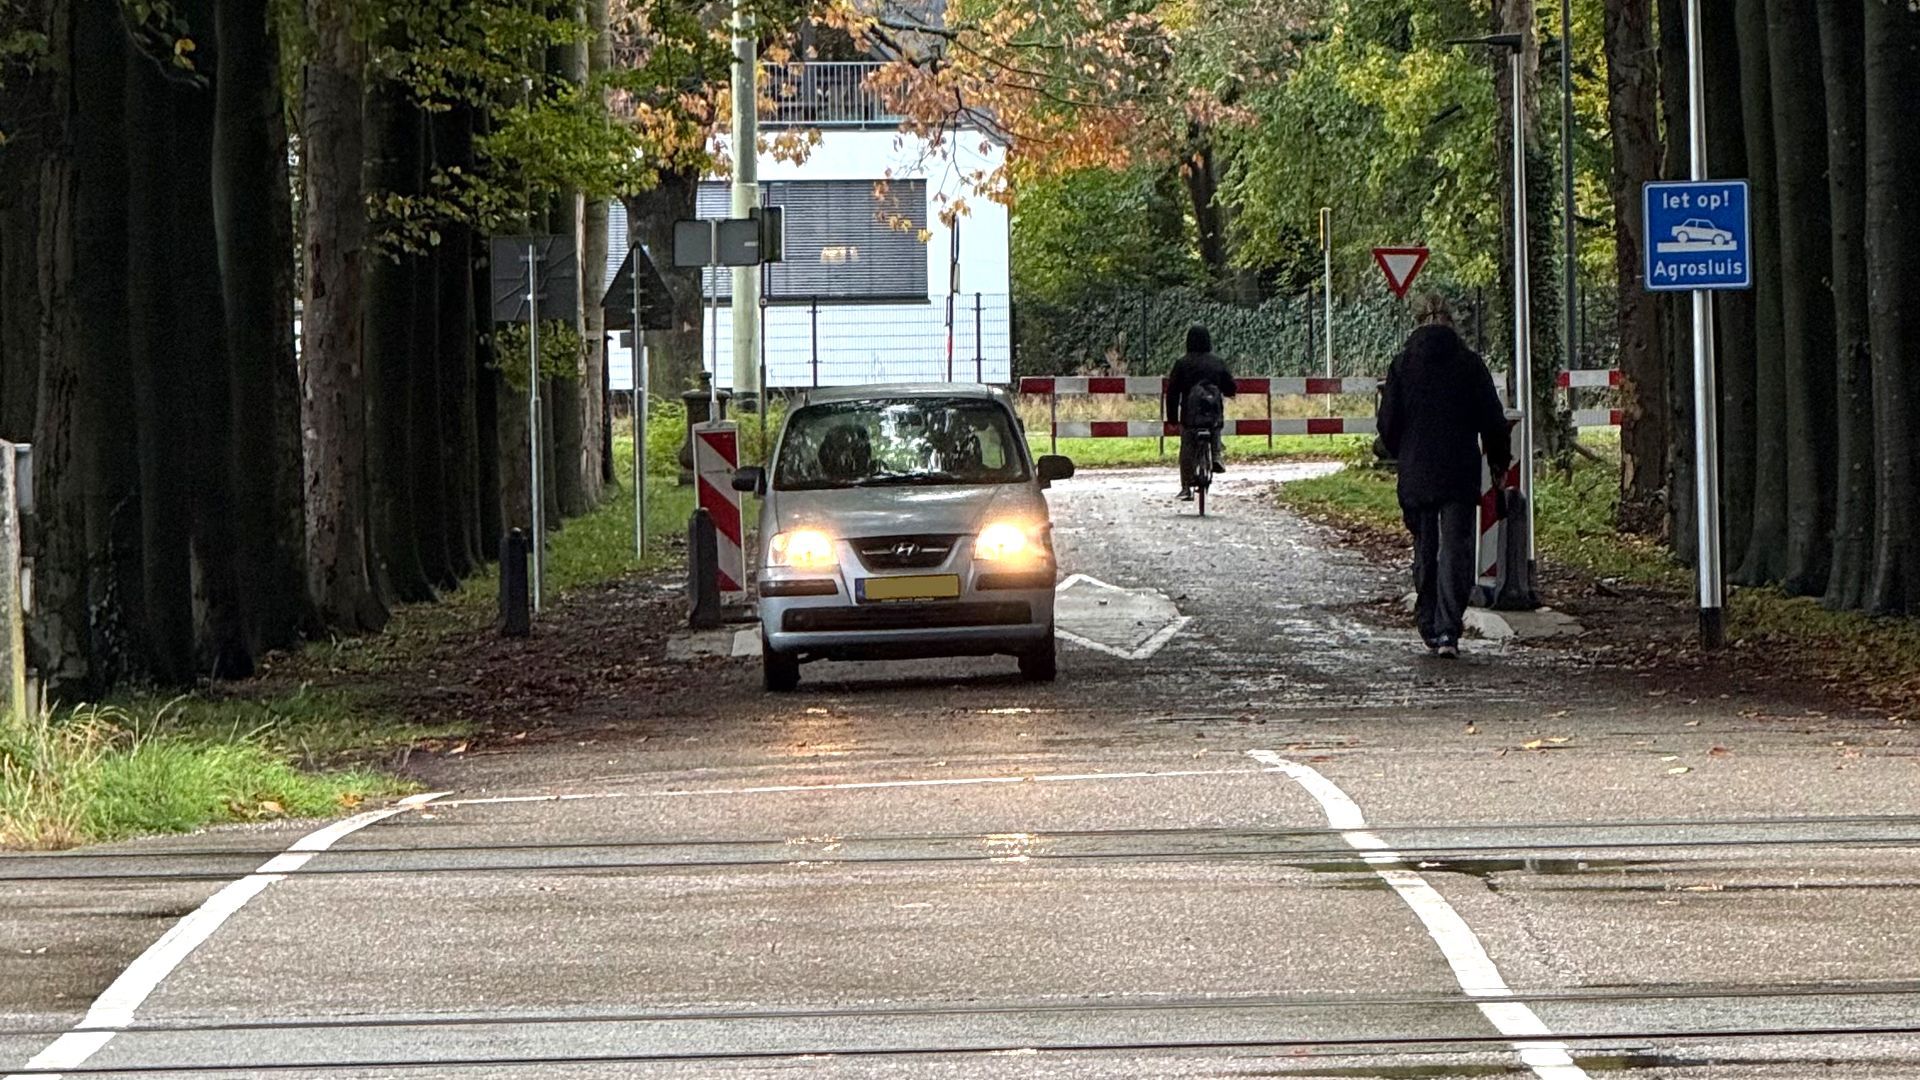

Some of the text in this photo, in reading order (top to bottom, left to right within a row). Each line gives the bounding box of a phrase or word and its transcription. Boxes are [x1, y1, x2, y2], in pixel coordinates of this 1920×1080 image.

[1662, 190, 1729, 210] let op!
[1653, 258, 1743, 281] Agrosluis
